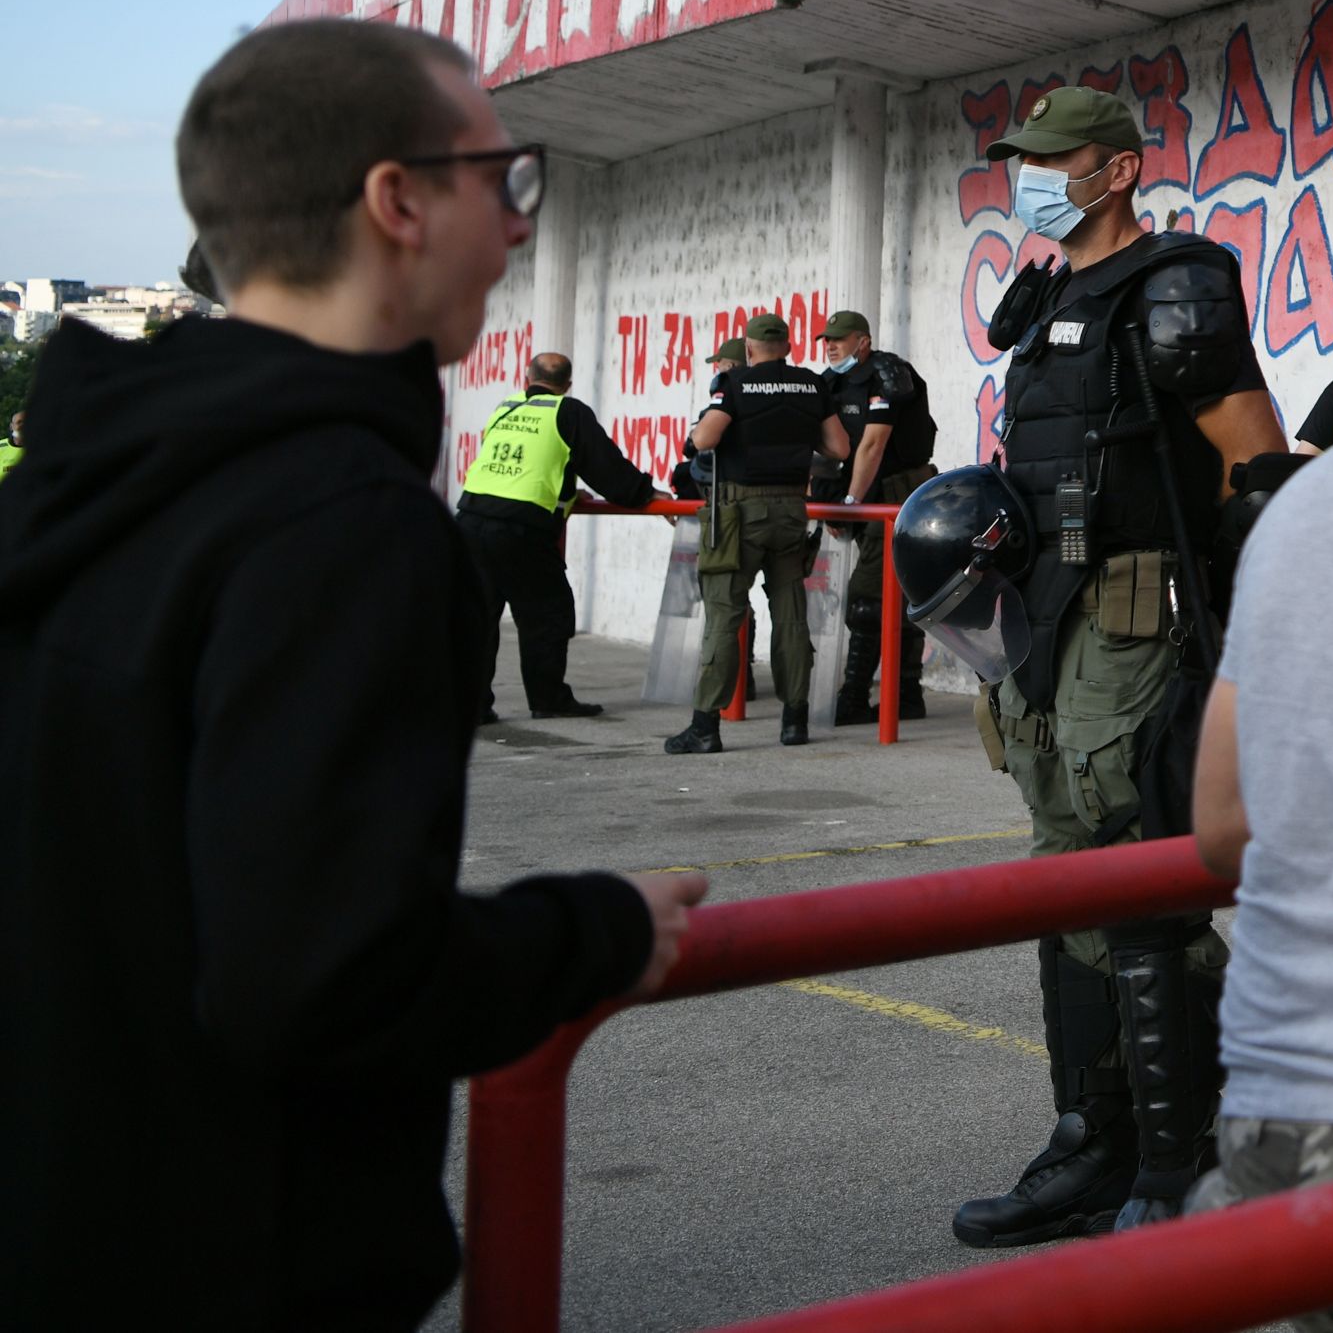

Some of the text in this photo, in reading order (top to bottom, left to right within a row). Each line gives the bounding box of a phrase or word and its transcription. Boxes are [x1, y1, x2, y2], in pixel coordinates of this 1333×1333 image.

[618, 314, 648, 395] ТИ
[661, 313, 694, 386] ЗА
[742, 382, 818, 395] ЖАНДАРМЕРИЈА
[492, 442, 524, 464] 134
